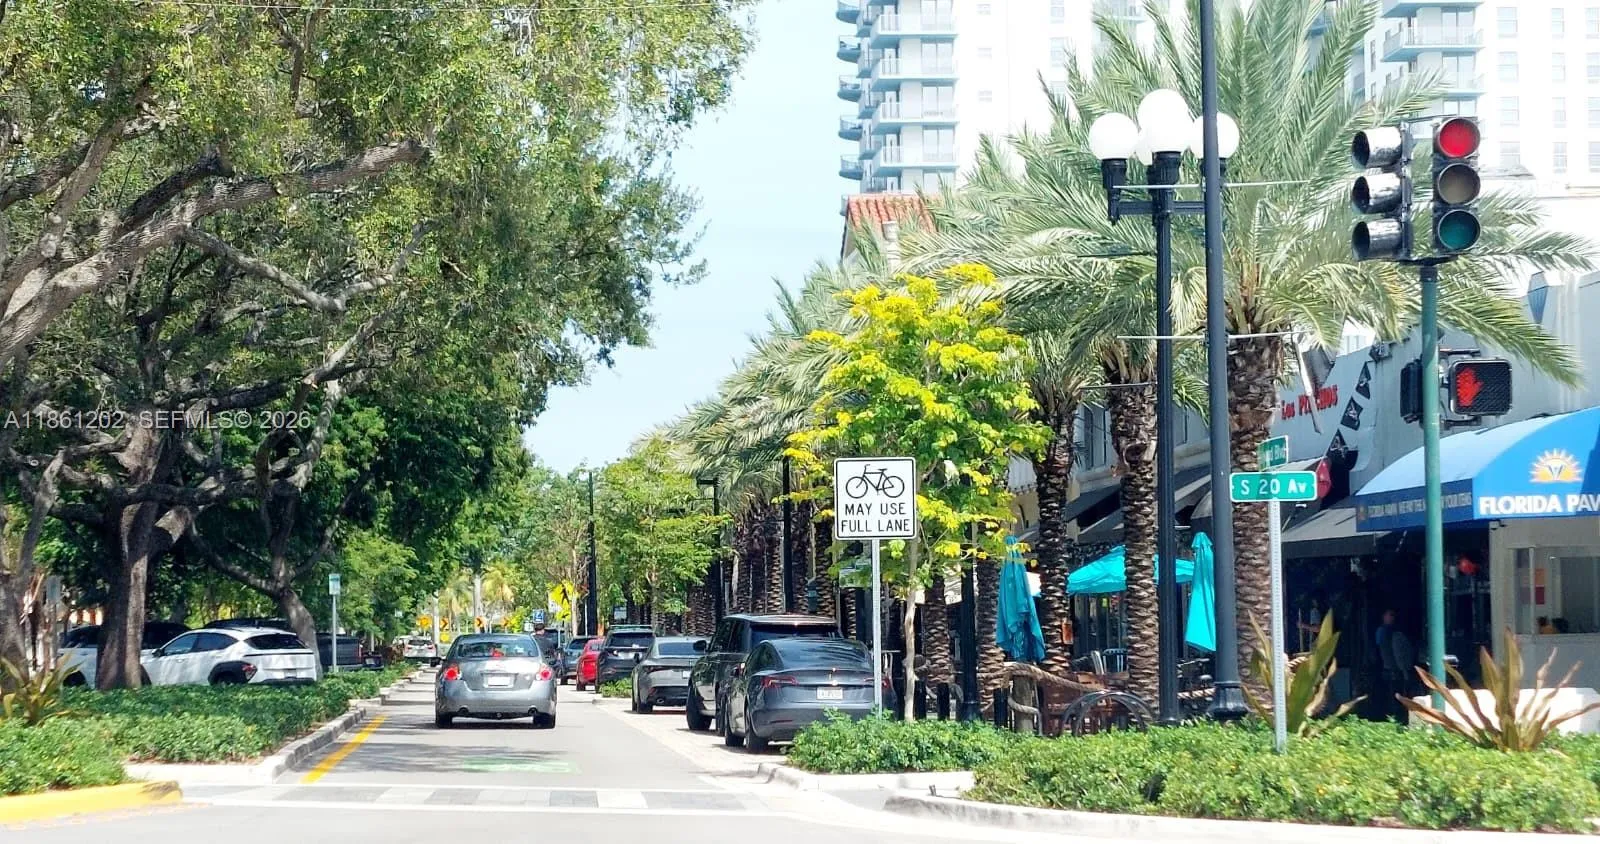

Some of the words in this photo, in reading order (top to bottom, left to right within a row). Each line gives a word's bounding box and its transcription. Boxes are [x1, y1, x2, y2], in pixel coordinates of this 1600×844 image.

[1240, 479, 1250, 495] S
[1259, 479, 1280, 495] 20
[1287, 479, 1307, 494] Av
[845, 503, 872, 516] MAY
[880, 502, 907, 515] USE
[1478, 494, 1563, 515] FLORIDA
[841, 519, 872, 532] FULL
[878, 519, 910, 532] LANE
